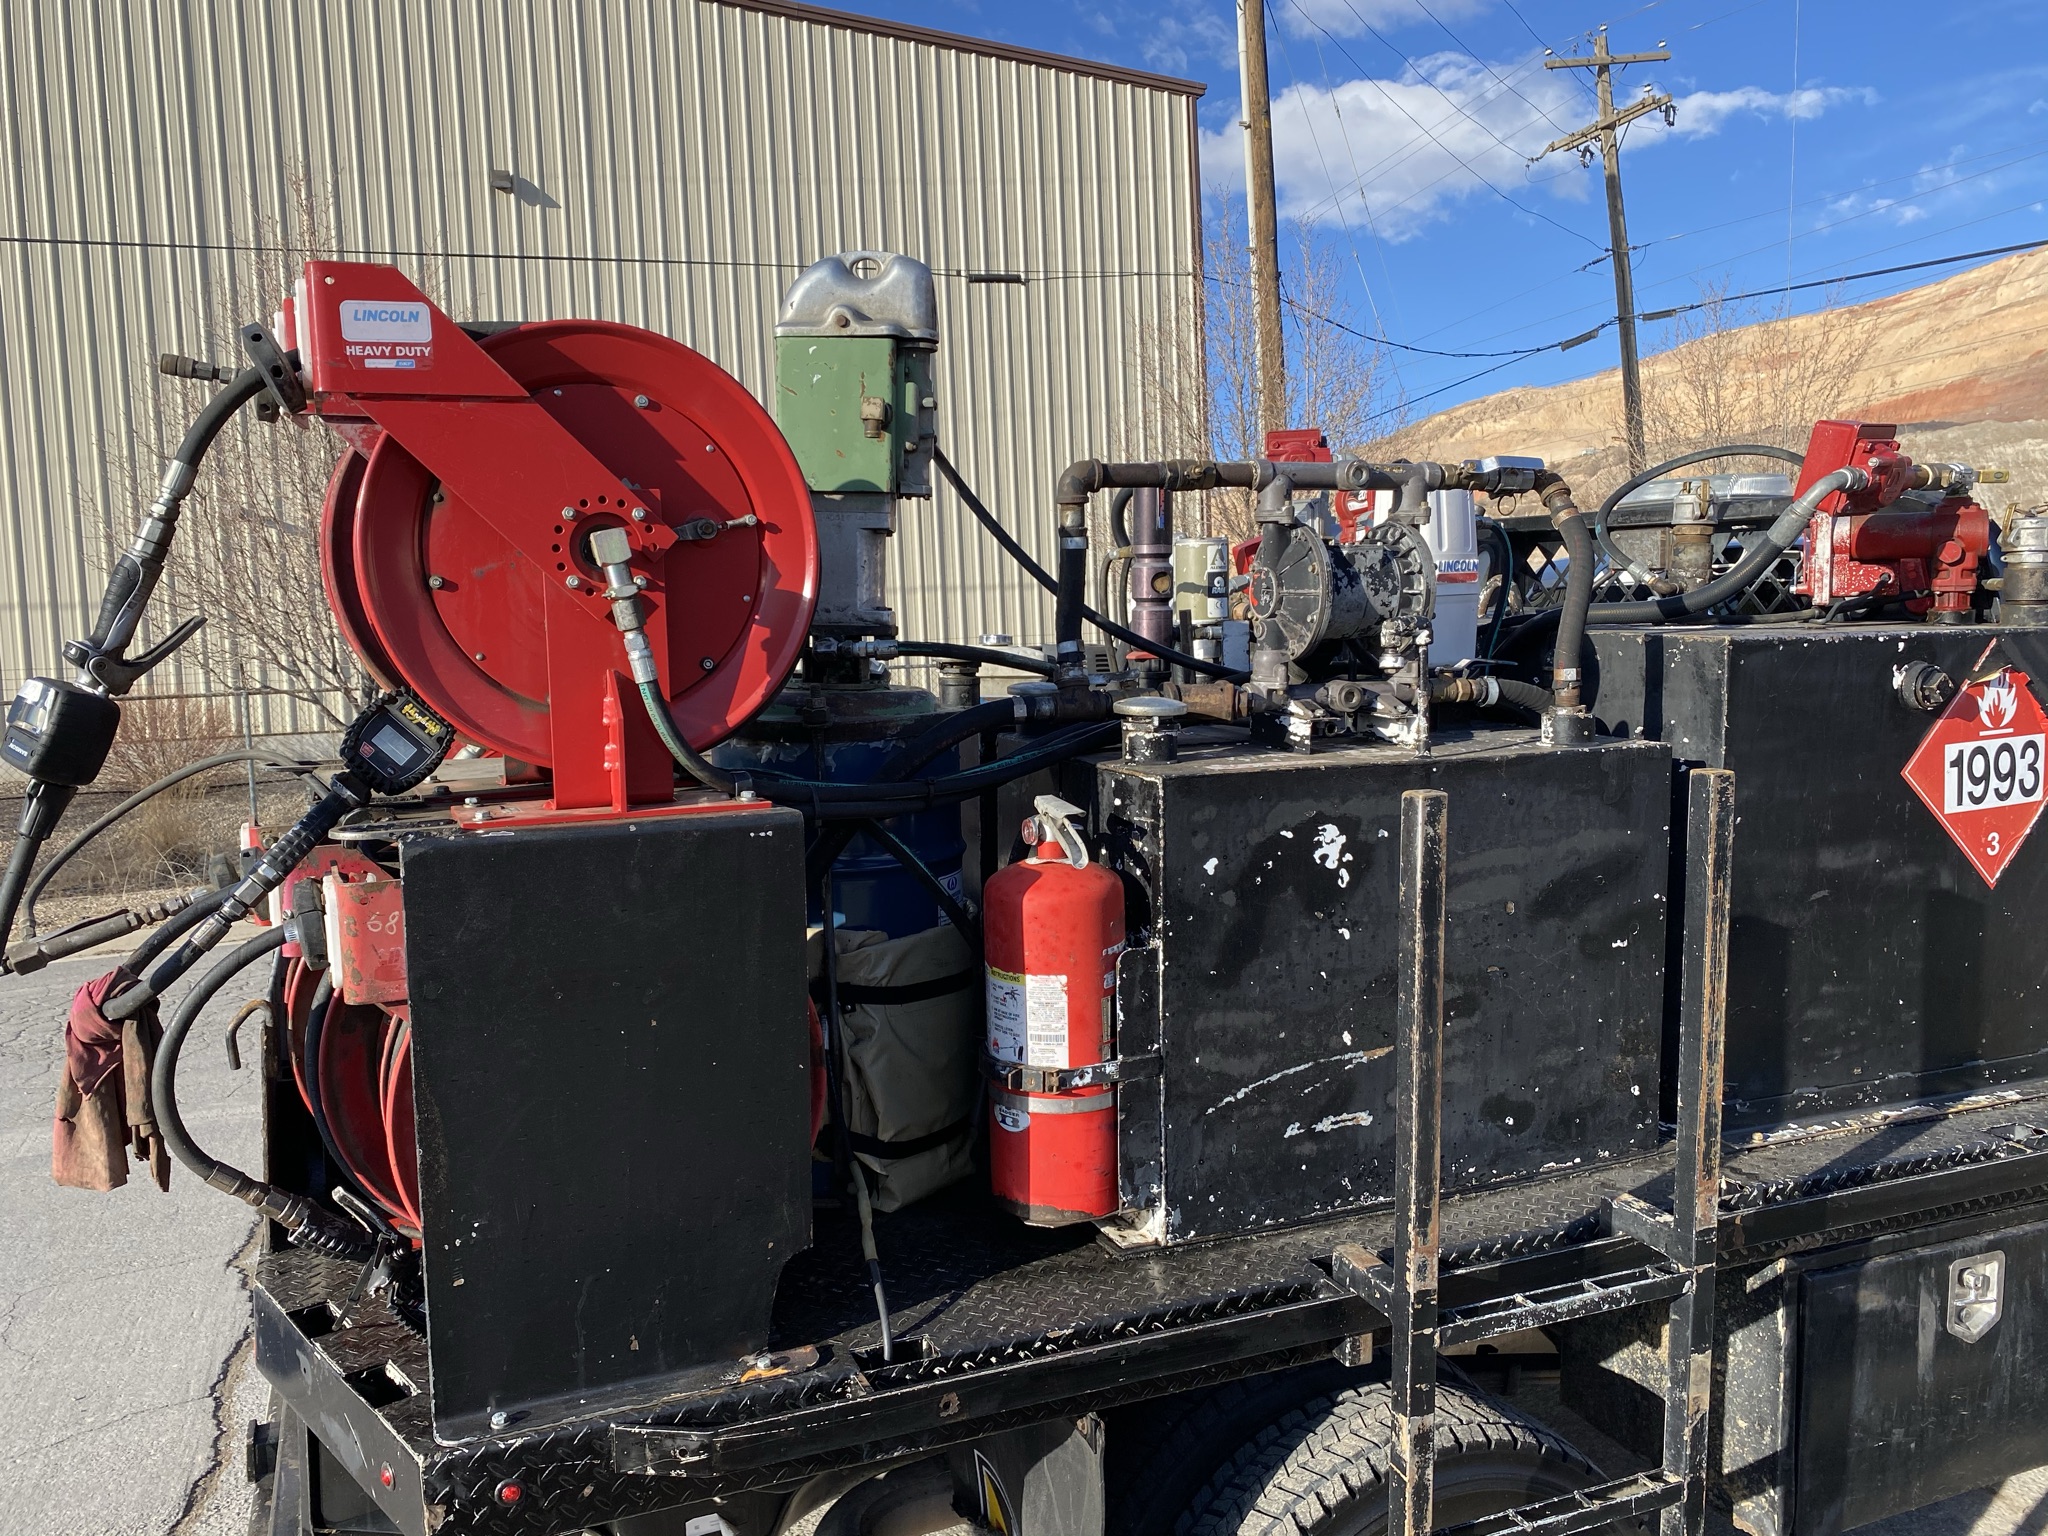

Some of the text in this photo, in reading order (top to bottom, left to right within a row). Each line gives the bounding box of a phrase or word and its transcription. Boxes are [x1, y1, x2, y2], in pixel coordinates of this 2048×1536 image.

[353, 309, 419, 323] LINCOLN
[346, 345, 431, 357] HEAVY DUTY
[1438, 560, 1479, 572] LINCOLN
[1949, 739, 2040, 807] 1993
[1986, 832, 2000, 856] 3
[367, 911, 400, 935] 68
